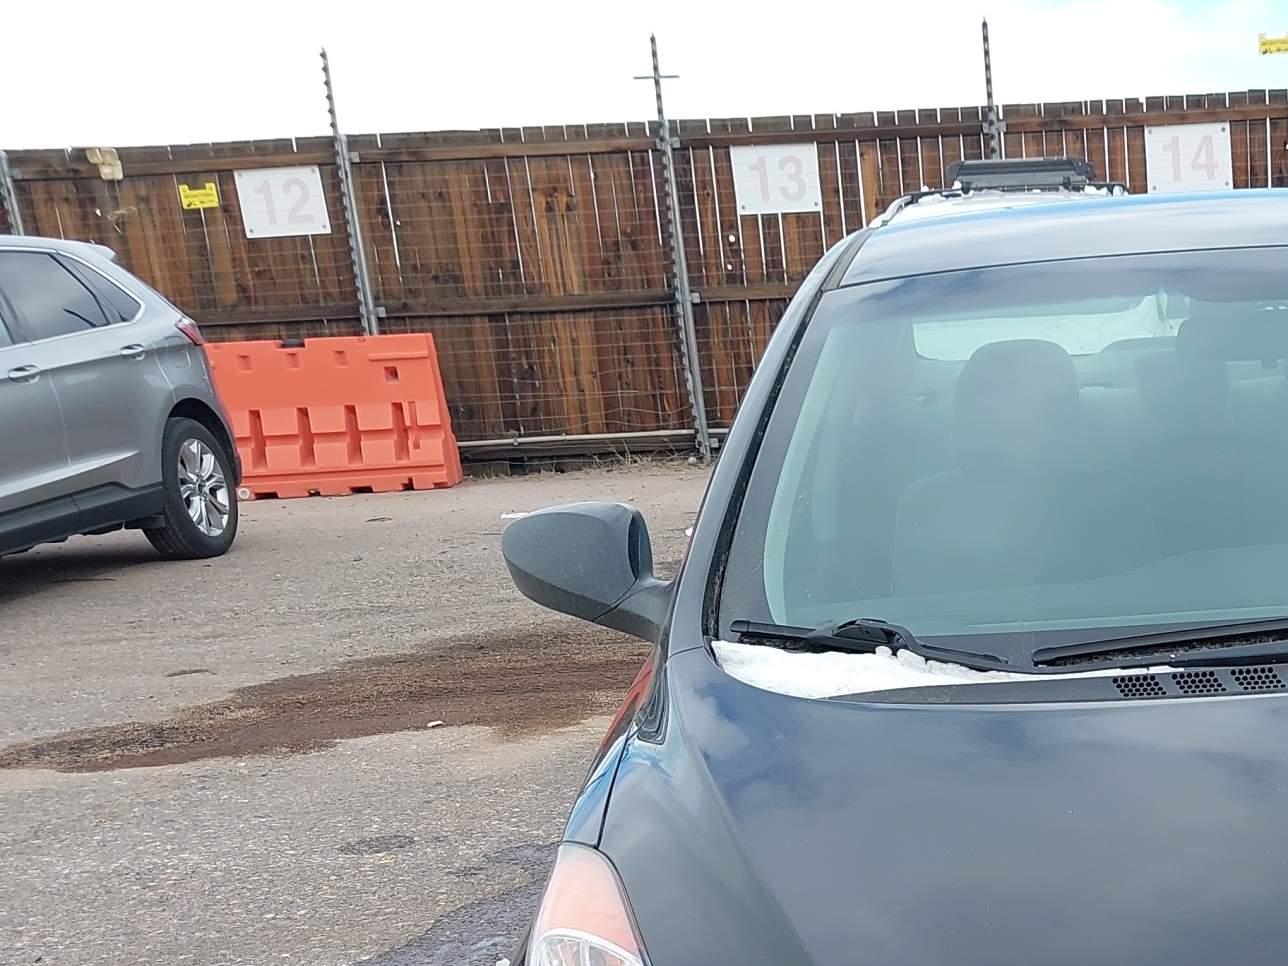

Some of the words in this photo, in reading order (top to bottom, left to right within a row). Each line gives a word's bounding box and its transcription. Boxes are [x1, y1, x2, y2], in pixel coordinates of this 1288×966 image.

[749, 155, 807, 202] 13
[1162, 134, 1218, 182] 14
[254, 177, 315, 224] 12
